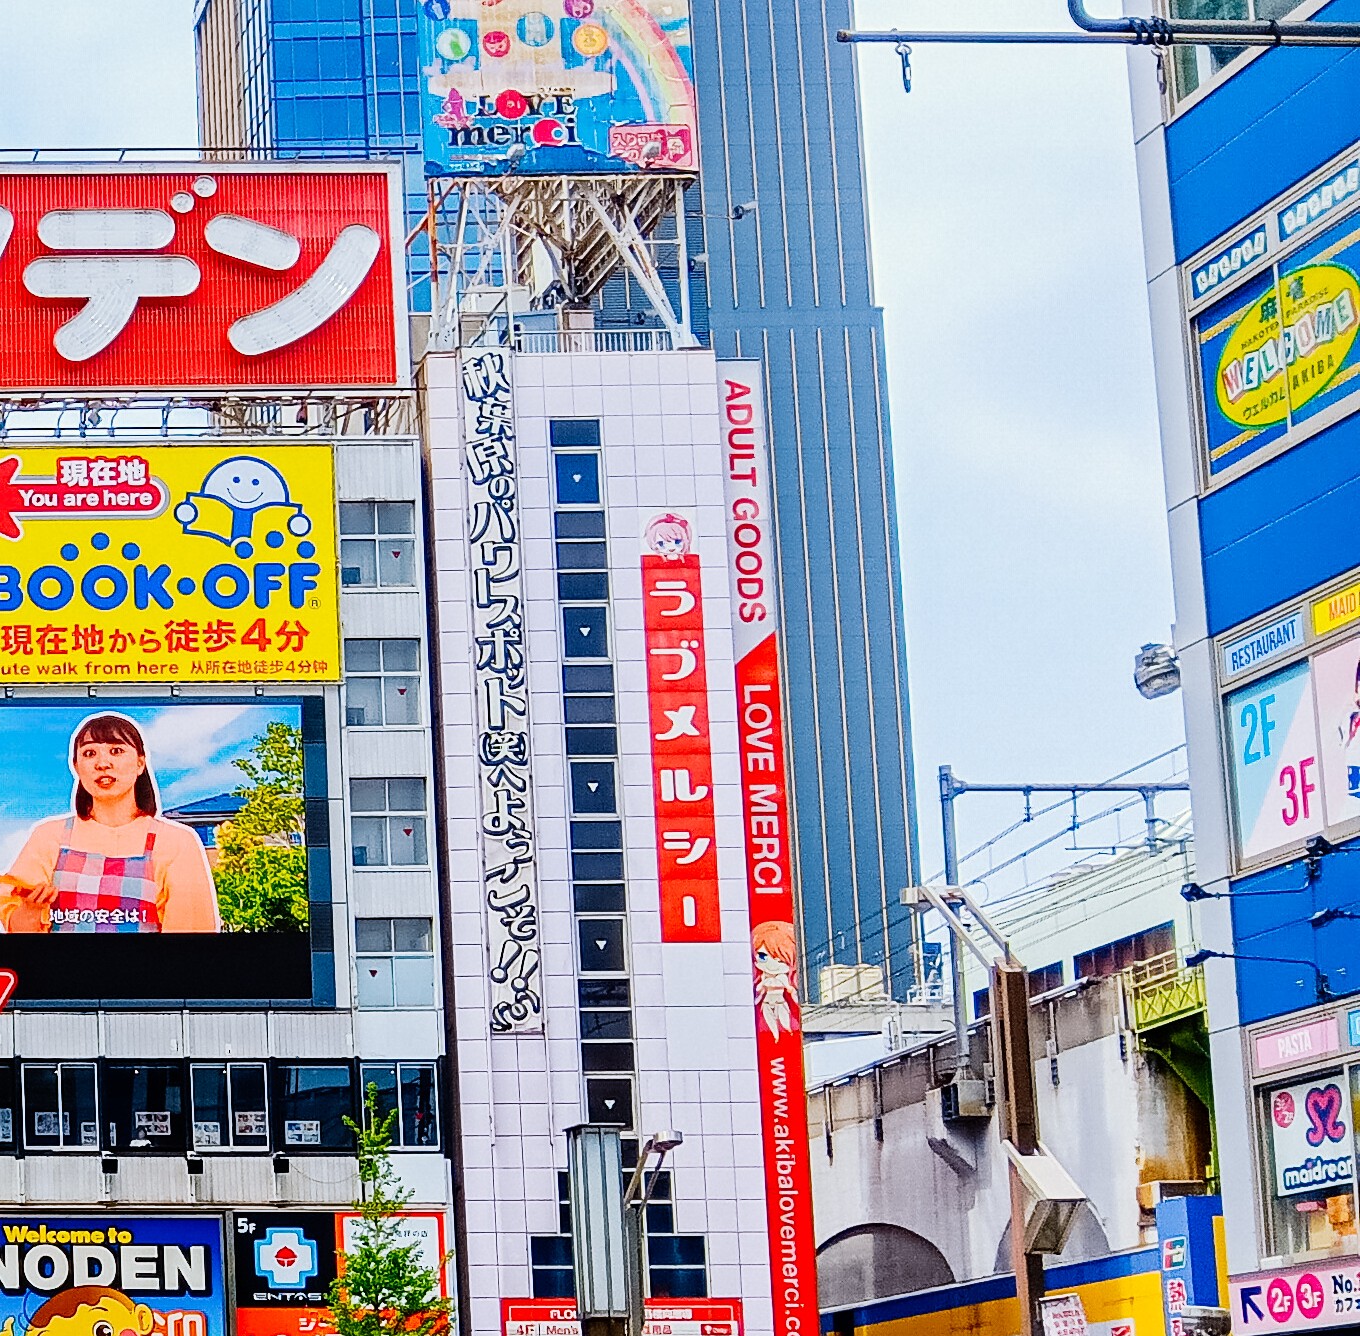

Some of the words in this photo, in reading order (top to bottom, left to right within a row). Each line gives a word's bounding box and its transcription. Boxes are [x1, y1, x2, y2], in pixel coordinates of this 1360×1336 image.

[1225, 297, 1352, 397] WELCOME
[1292, 355, 1335, 391] AKIBA
[721, 378, 757, 488] ADULT
[58, 458, 148, 487] 現在地
[19, 488, 58, 508] You
[62, 492, 98, 508] are
[102, 488, 154, 508] here
[731, 498, 766, 624] GOODS
[1329, 598, 1356, 621] MAID
[0, 617, 310, 658] 現在地から徒歩4分
[1231, 619, 1297, 672] RESTAURANT
[37, 659, 81, 676] walk
[85, 659, 126, 676] from
[137, 659, 180, 676] here
[740, 683, 774, 768] LOVE
[1241, 693, 1276, 766] 2F
[649, 579, 710, 928] ラブメルシー
[1279, 756, 1316, 827] 3F
[747, 777, 784, 896] MERCI
[1277, 1029, 1313, 1059] PASTA
[3, 1225, 104, 1244] Welcome
[108, 1225, 132, 1244] to
[237, 1217, 256, 1234] 5F
[1271, 1288, 1292, 1314] 2F
[1300, 1283, 1322, 1310] 3F
